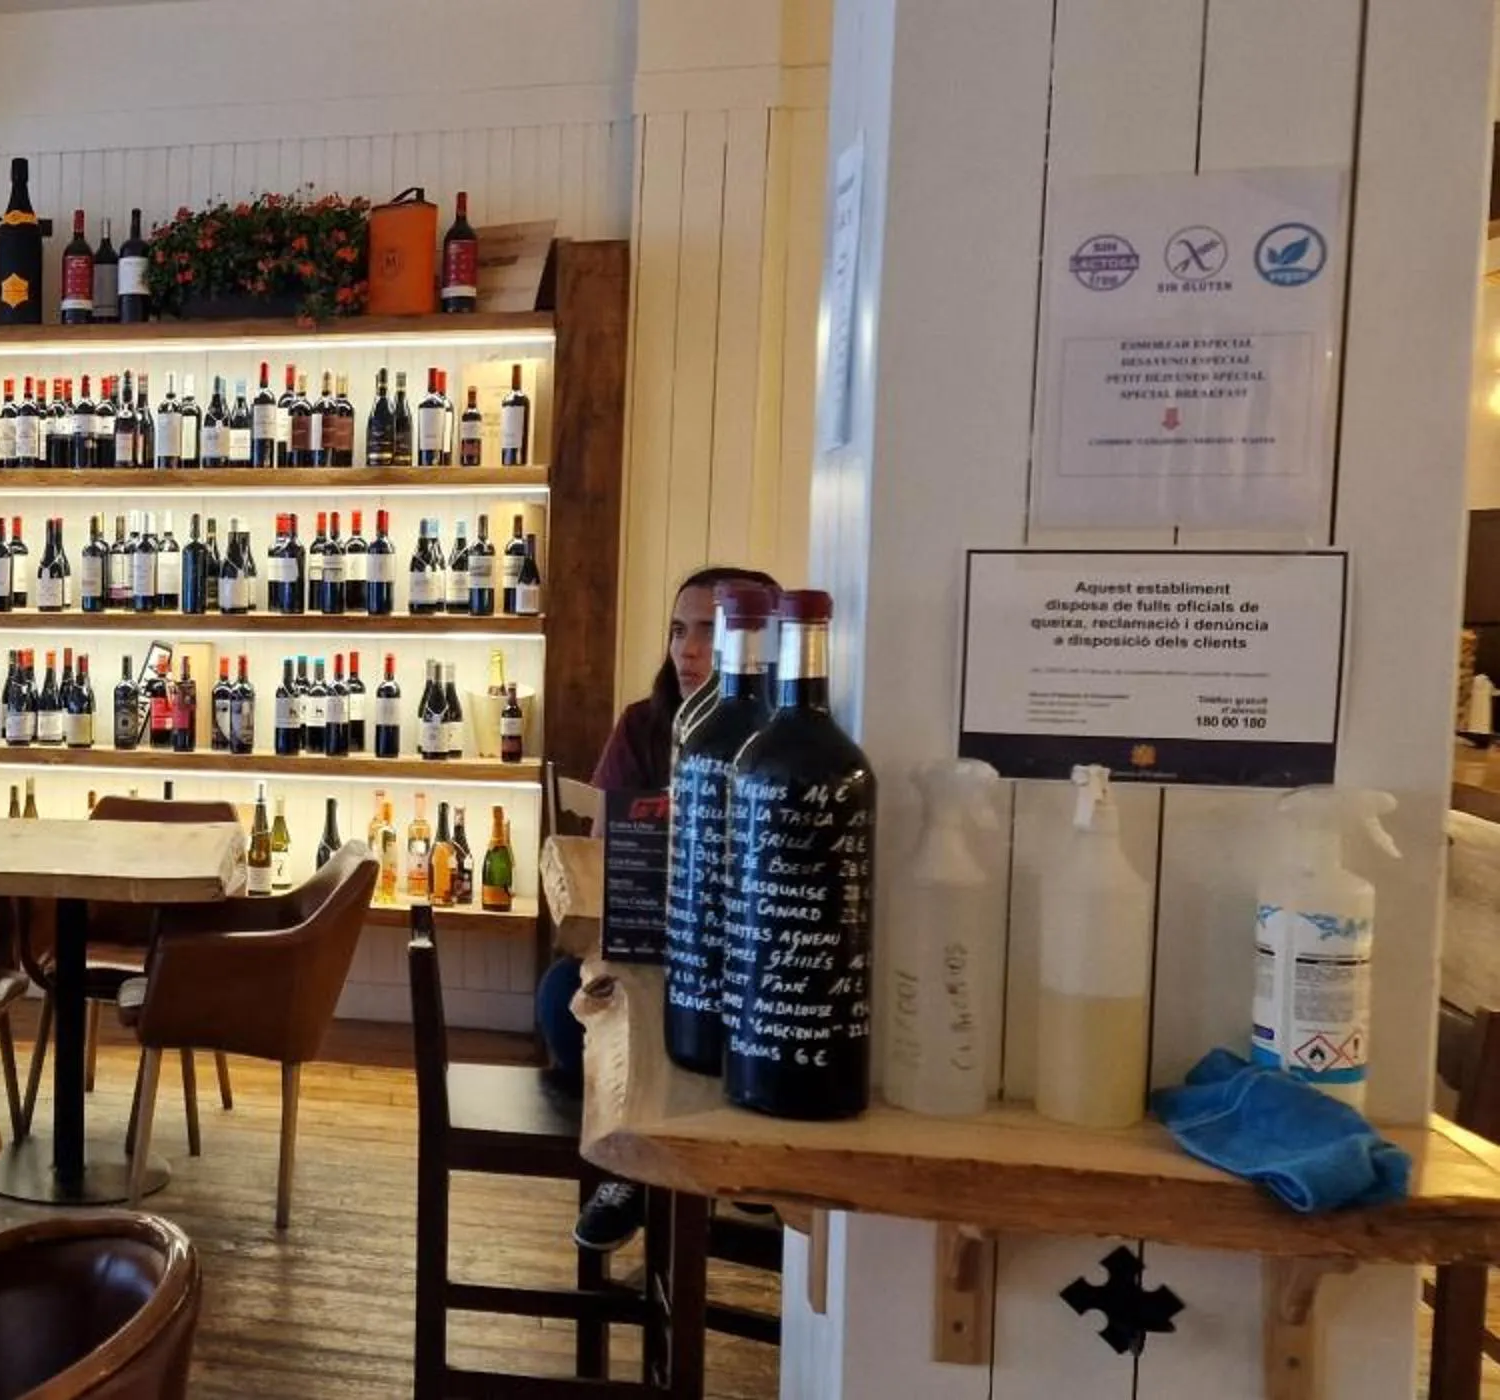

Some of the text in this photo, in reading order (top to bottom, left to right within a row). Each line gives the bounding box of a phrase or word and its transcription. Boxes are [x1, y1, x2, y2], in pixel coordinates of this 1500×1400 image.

[1075, 581, 1231, 596] Aquest establiment
[1045, 599, 1260, 614] disposa de fulls oficials de
[1092, 617, 1180, 632] reclamació
[1194, 618, 1269, 632] denúncia
[1067, 635, 1151, 650] disposició
[1155, 636, 1188, 649] dels
[1193, 637, 1248, 650] clients
[1222, 716, 1239, 729] 00
